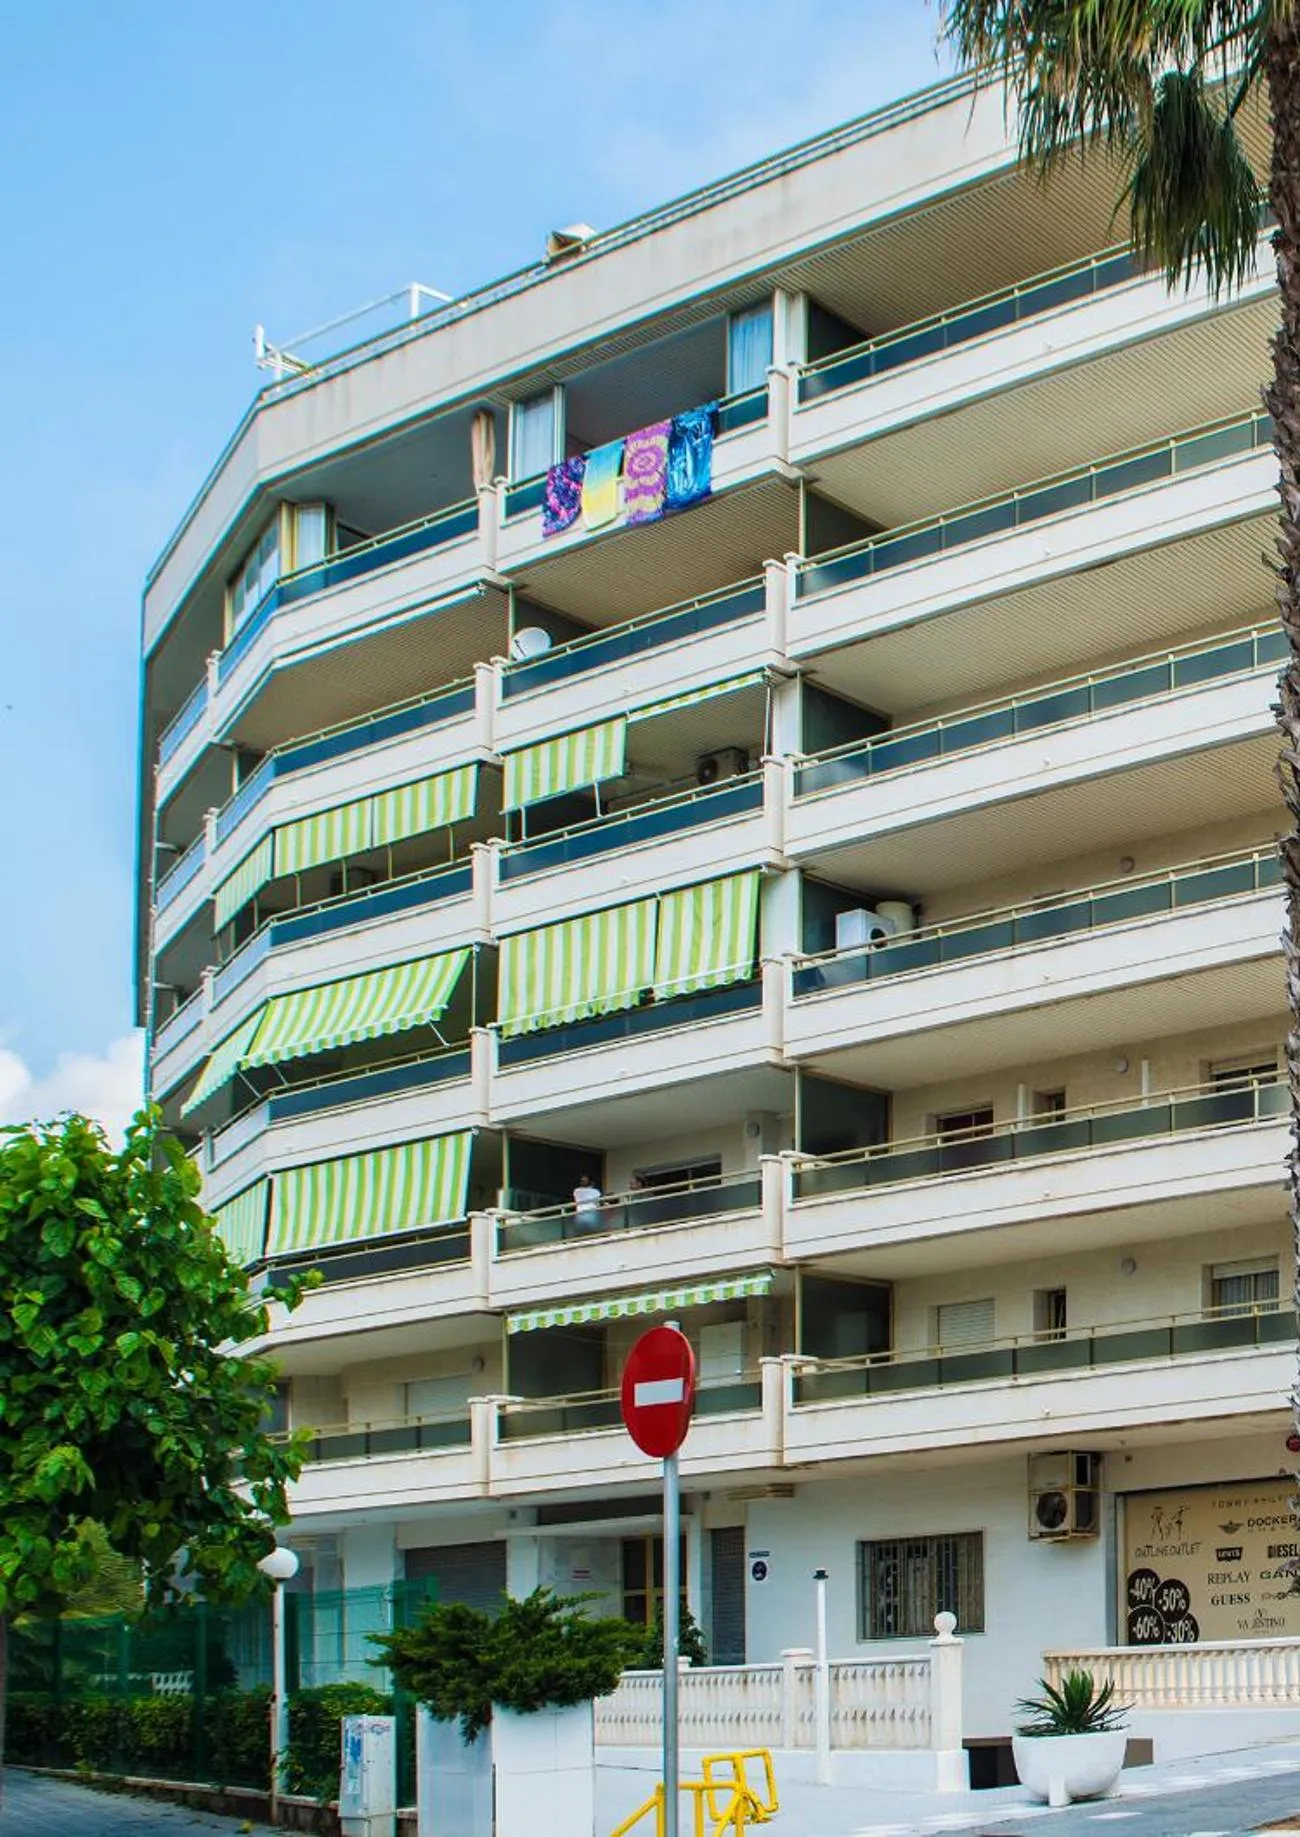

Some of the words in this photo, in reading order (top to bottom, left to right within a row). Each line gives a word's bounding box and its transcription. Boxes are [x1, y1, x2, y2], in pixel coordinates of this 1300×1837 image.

[1247, 1514, 1298, 1528] DOCKER
[1267, 1543, 1299, 1559] DIESEL
[1207, 1570, 1250, 1585] REPLAY
[1259, 1569, 1298, 1580] GAN
[1158, 1588, 1186, 1611] -50%
[1210, 1592, 1251, 1607] GUESS
[1132, 1615, 1160, 1638] -60%
[1167, 1620, 1195, 1642] -30%
